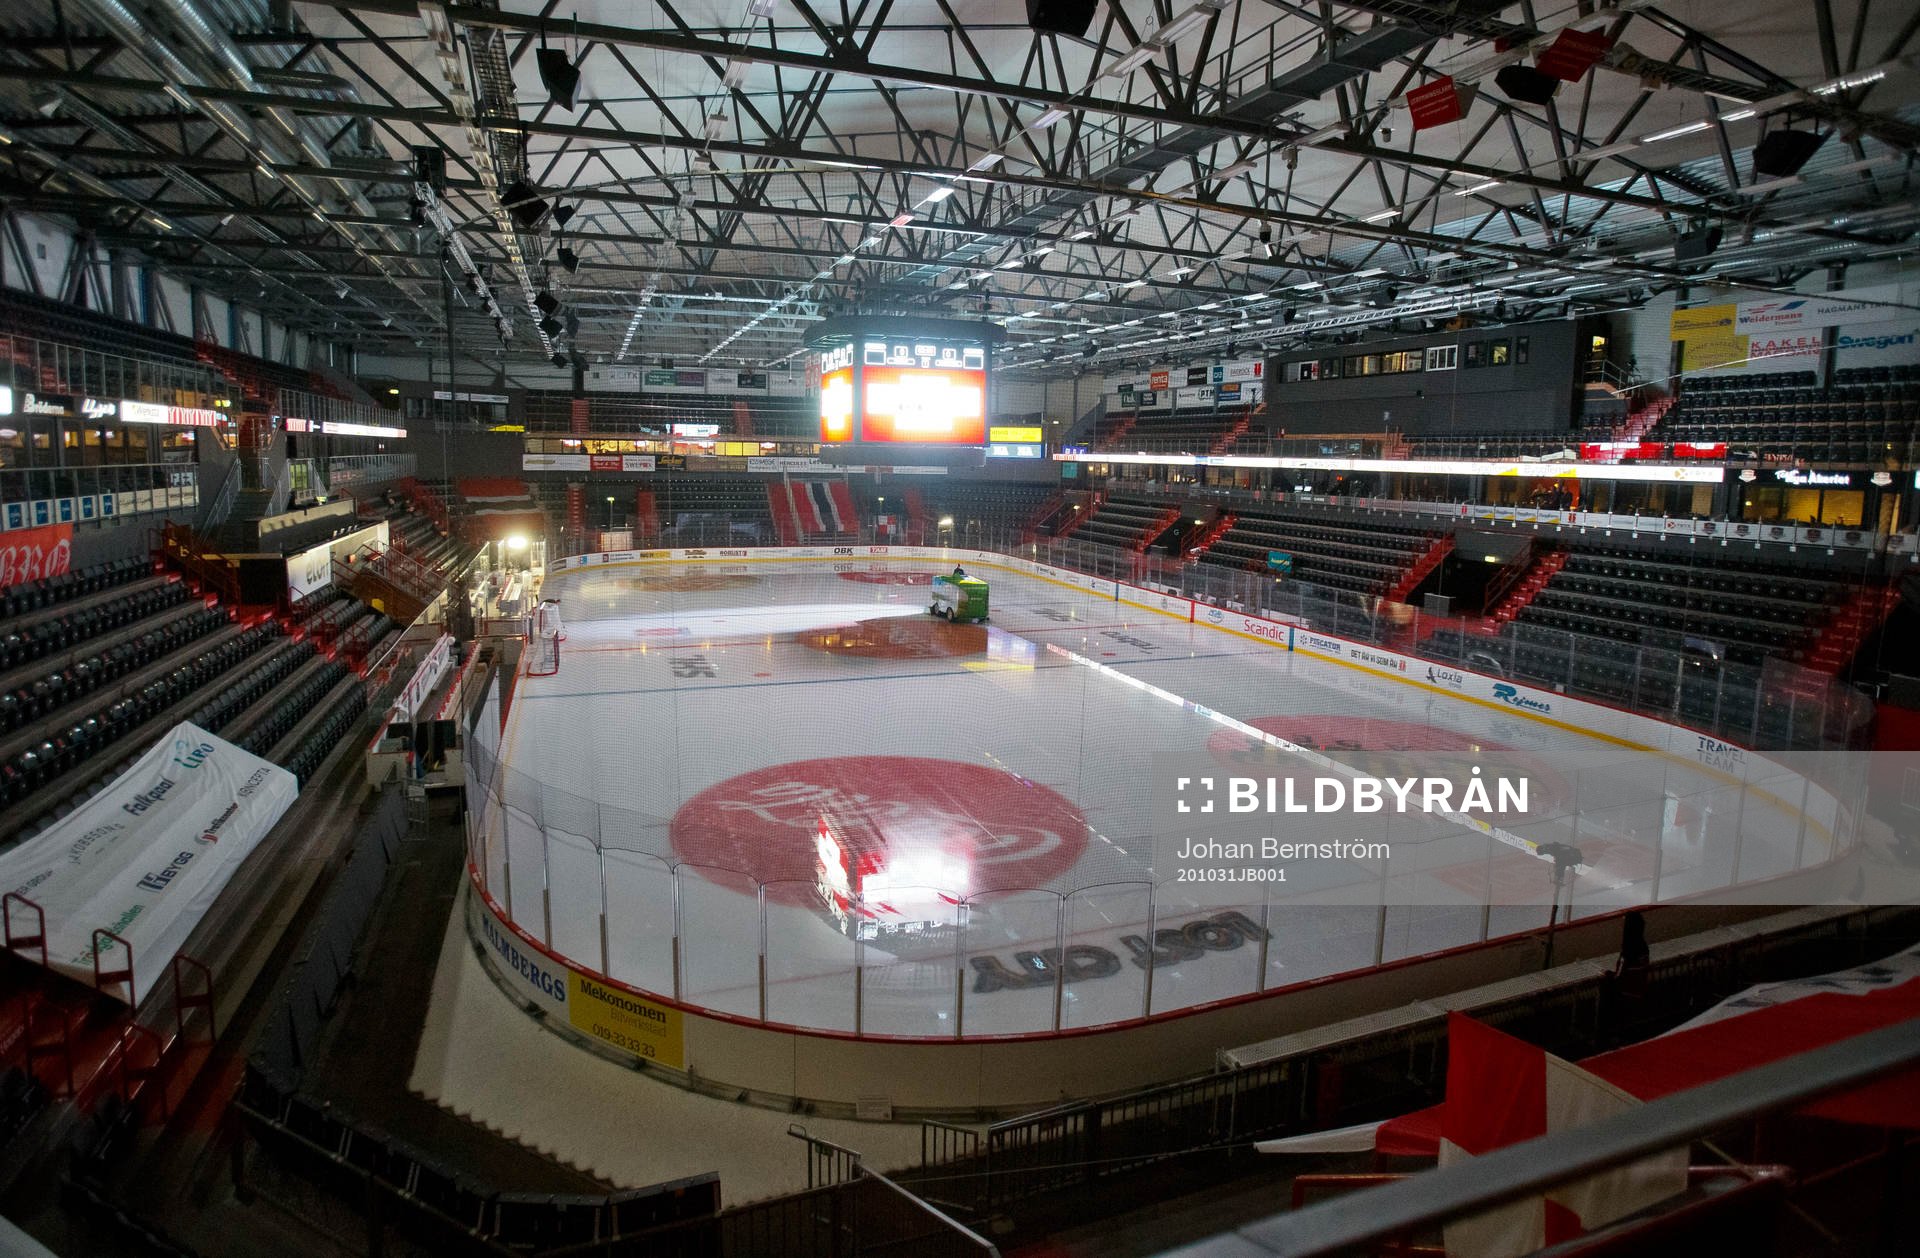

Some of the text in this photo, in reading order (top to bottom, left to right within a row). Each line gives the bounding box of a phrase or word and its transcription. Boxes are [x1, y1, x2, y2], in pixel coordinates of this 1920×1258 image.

[1739, 311, 1803, 325] Weidermans
[1817, 303, 1866, 315] HAGMANS
[1751, 336, 1822, 350] KAKEL
[1839, 335, 1915, 350] Swegon
[1244, 619, 1285, 642] Scandic
[1437, 668, 1463, 684] Loxia
[1697, 735, 1748, 764] TRAVEL
[1696, 749, 1735, 774] TEAM
[482, 913, 567, 1003] MALMBERGS
[580, 979, 667, 1023] Mekonomen
[627, 1034, 641, 1053] 33
[641, 1038, 656, 1058] 33
